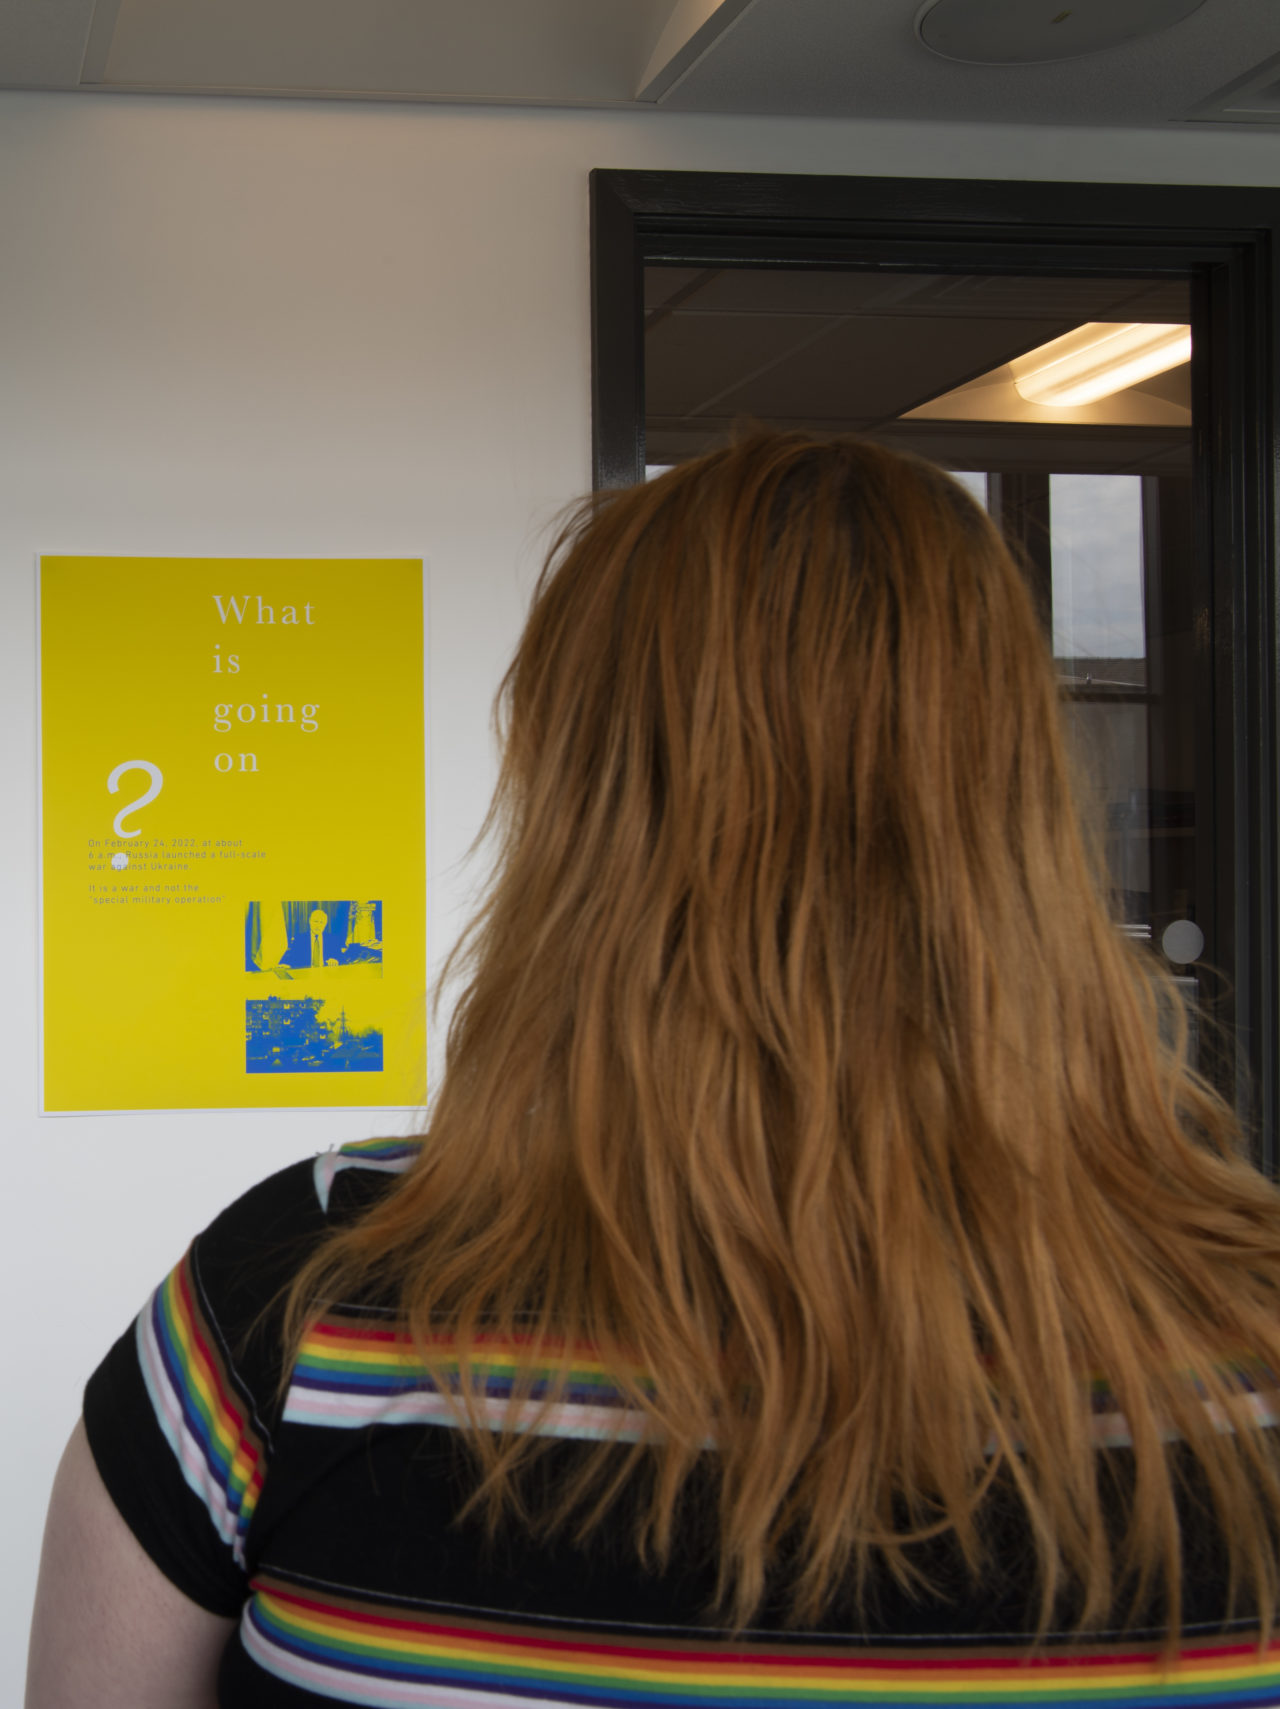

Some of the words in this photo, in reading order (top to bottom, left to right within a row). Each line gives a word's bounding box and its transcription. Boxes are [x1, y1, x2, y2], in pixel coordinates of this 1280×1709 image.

[212, 595, 316, 625] What
[212, 644, 240, 674] is
[213, 693, 320, 733] going
[214, 752, 260, 772] on
[107, 760, 163, 870] ?
